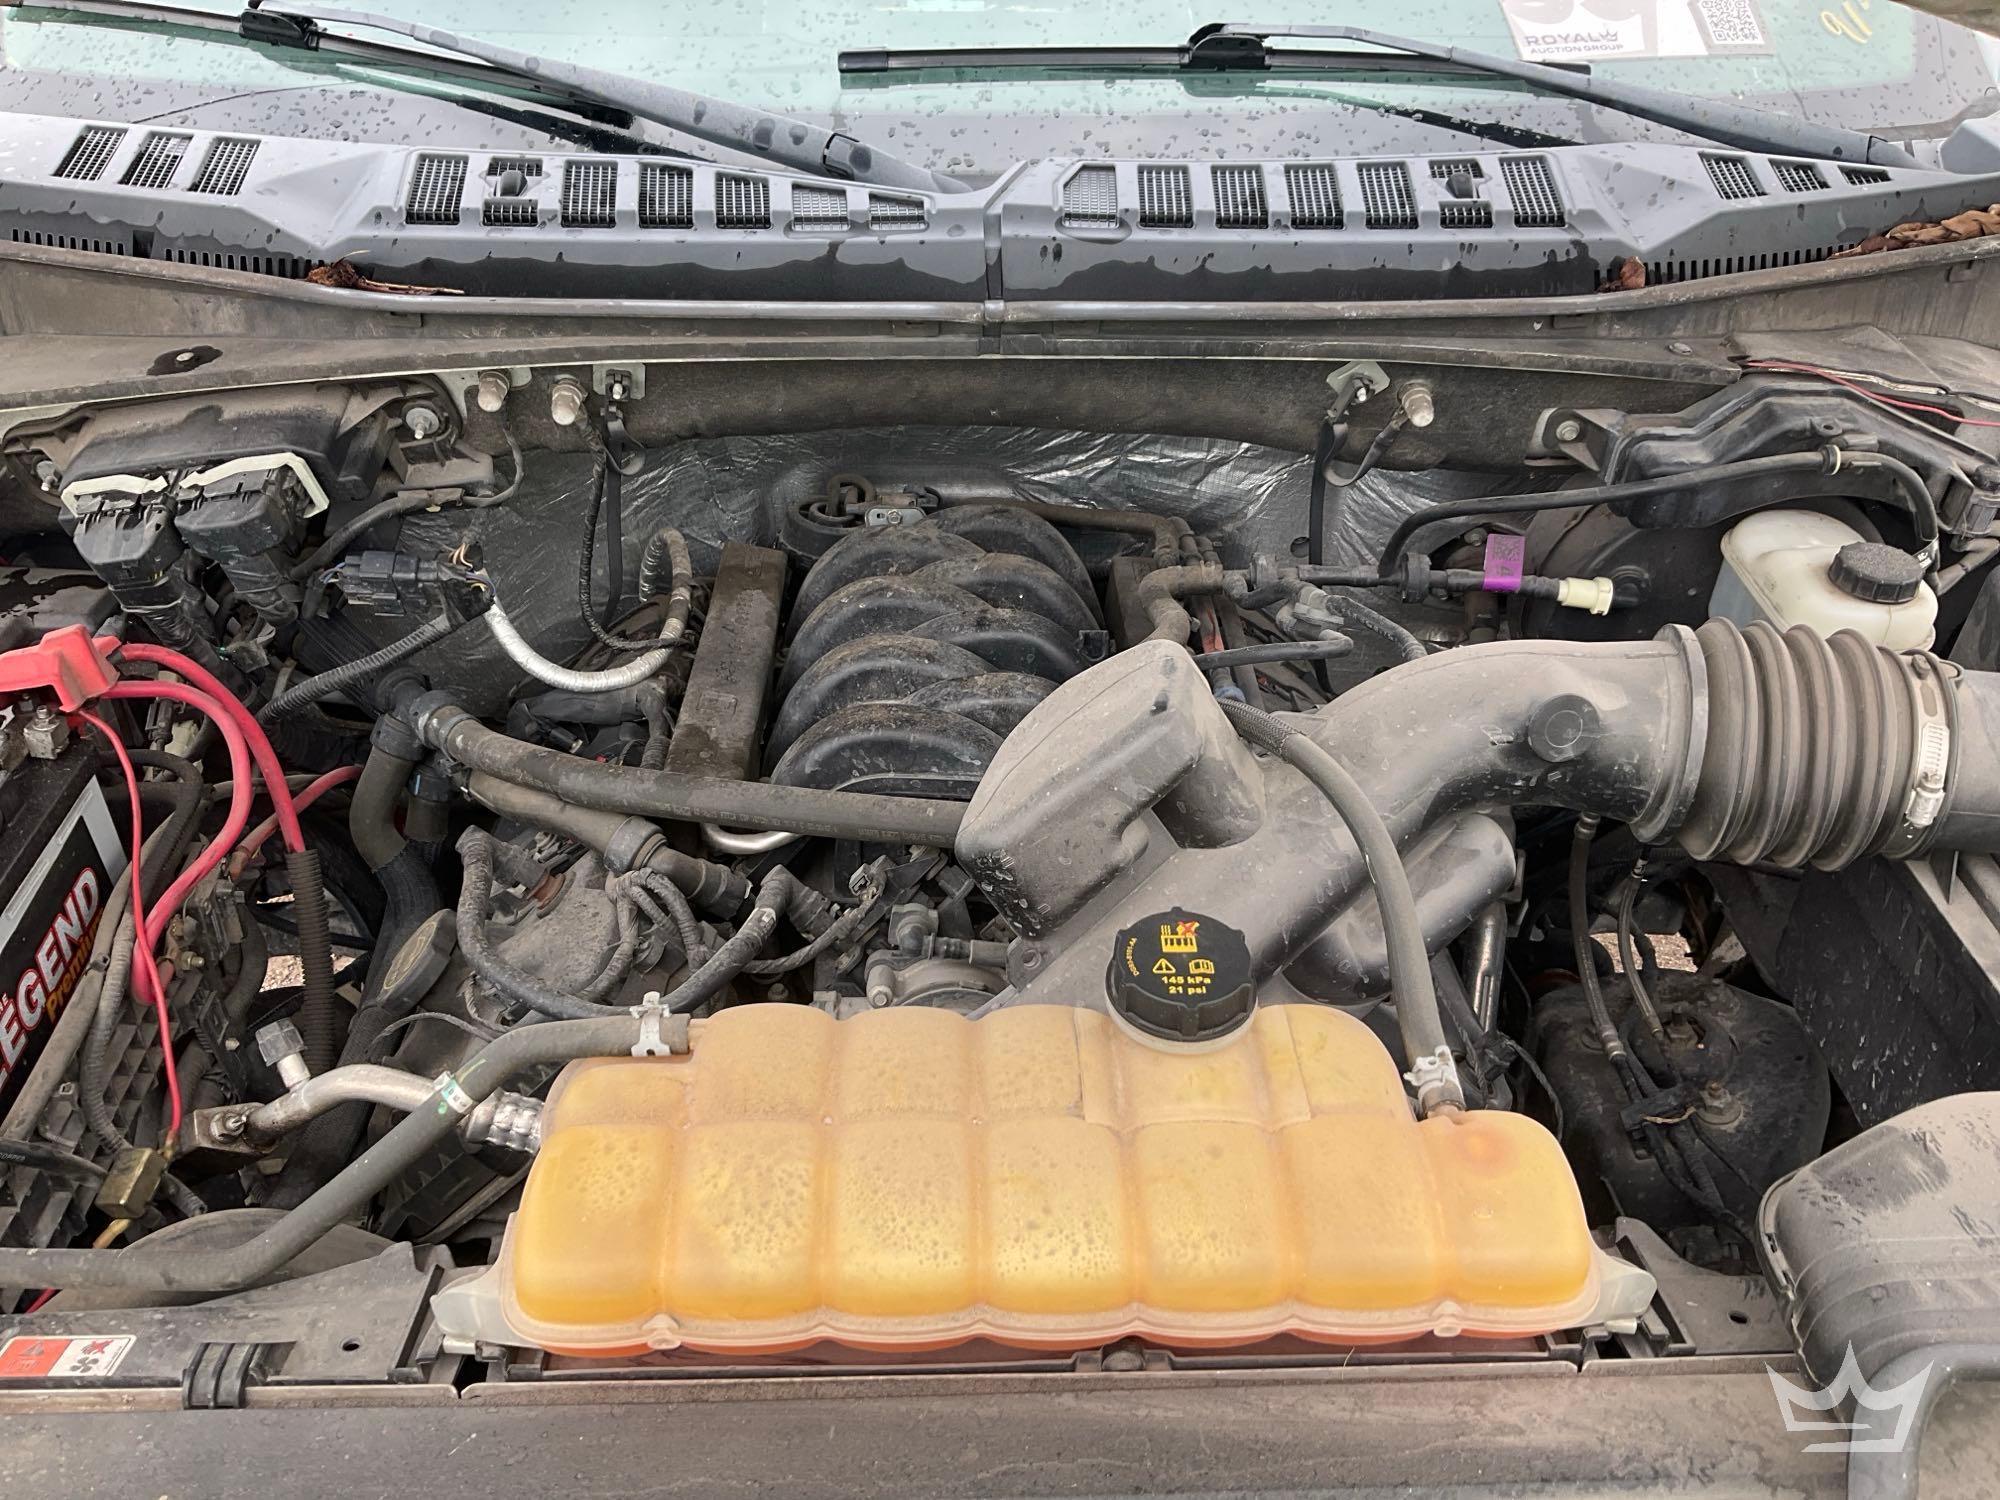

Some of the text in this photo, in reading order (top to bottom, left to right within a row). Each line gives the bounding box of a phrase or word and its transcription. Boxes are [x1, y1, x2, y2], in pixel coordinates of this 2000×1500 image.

[1525, 32, 1600, 46] ROYAL
[1531, 44, 1624, 54] AUCTION GROUP
[1161, 975, 1211, 984] 145 kPa
[1168, 985, 1207, 996] 21 psi
